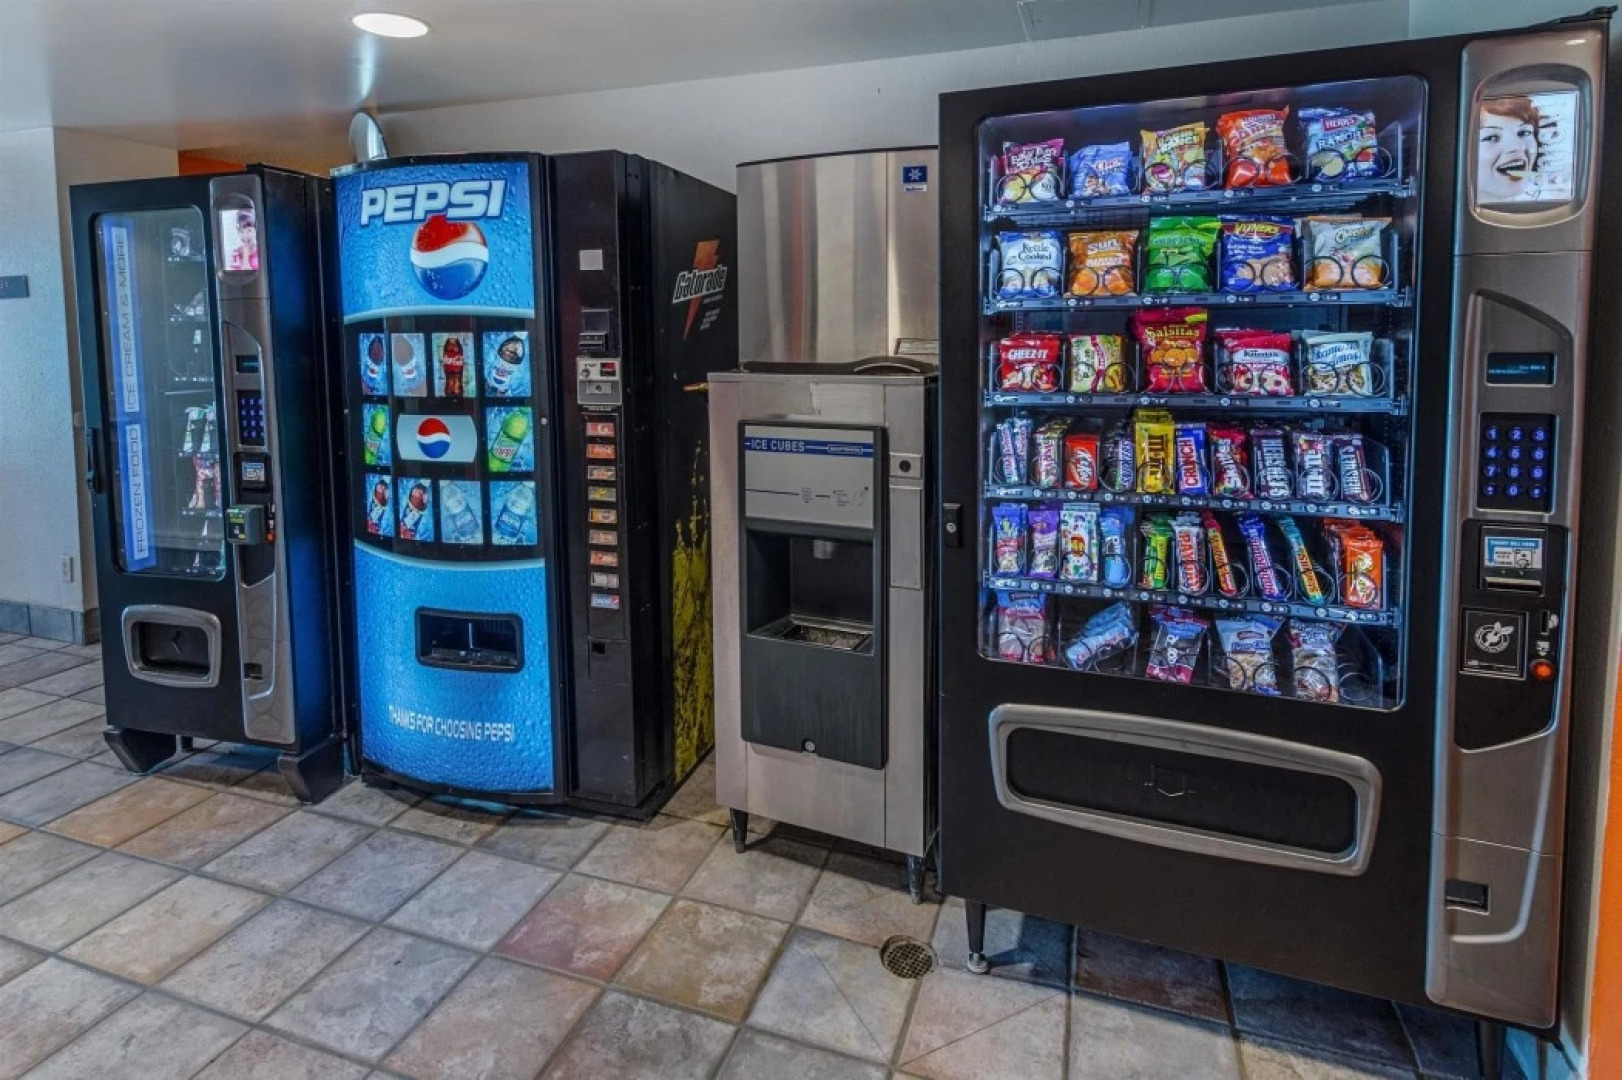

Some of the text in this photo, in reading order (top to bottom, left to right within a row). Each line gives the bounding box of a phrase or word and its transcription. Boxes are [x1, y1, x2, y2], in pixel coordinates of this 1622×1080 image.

[360, 179, 506, 227] PEPSI
[115, 233, 128, 288] MORE
[1018, 252, 1052, 260] Cooked
[673, 265, 728, 304] Gatorade
[122, 312, 136, 377] CREAM
[125, 382, 139, 410] ICE
[751, 438, 805, 452] ICE CUBES
[1179, 440, 1199, 485] CRUNCH
[129, 428, 146, 553] FROZEN FOOD
[416, 713, 433, 734] FOR
[434, 717, 482, 740] CHOOSING
[484, 721, 515, 742] PEPSI
